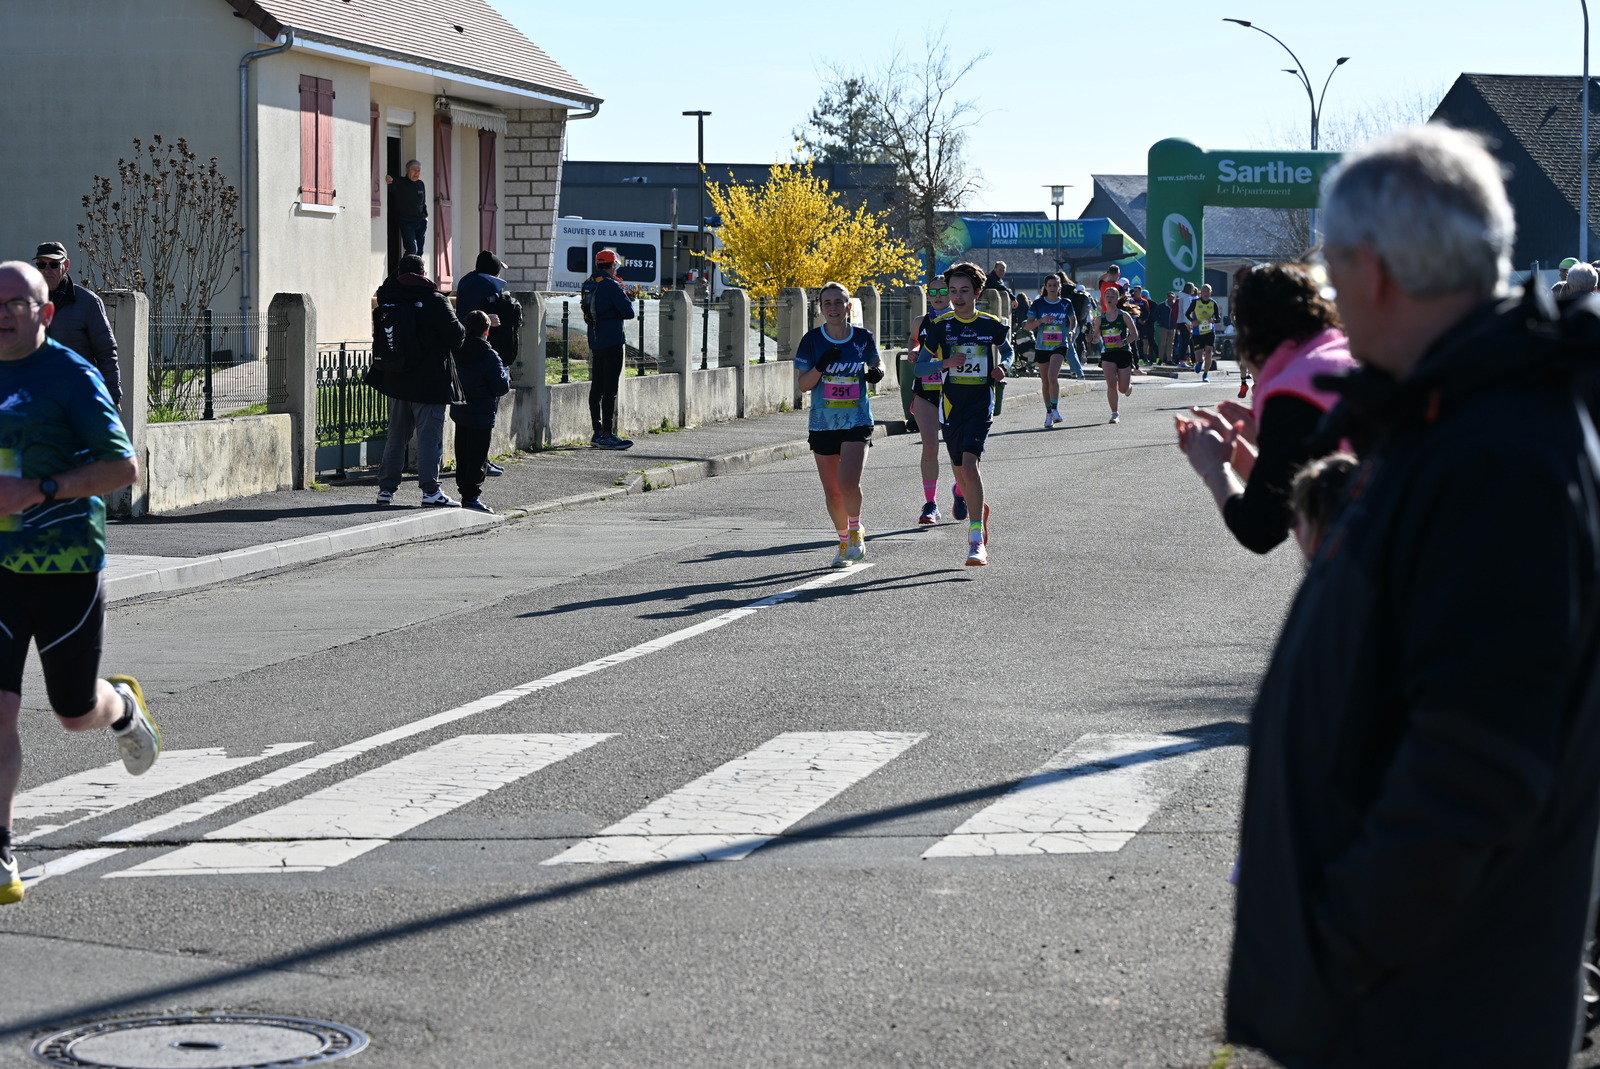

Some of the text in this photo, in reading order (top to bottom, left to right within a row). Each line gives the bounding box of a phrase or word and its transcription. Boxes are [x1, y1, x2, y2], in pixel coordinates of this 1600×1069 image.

[1217, 159, 1313, 184] Sarthe
[1157, 173, 1206, 181] www.sarthe.fr
[1216, 185, 1291, 197] Le Département
[608, 229, 617, 237] LA
[619, 230, 645, 238] SARTHE
[625, 259, 654, 269] FFSS 72
[955, 363, 981, 373] 924
[831, 386, 851, 397] 251
